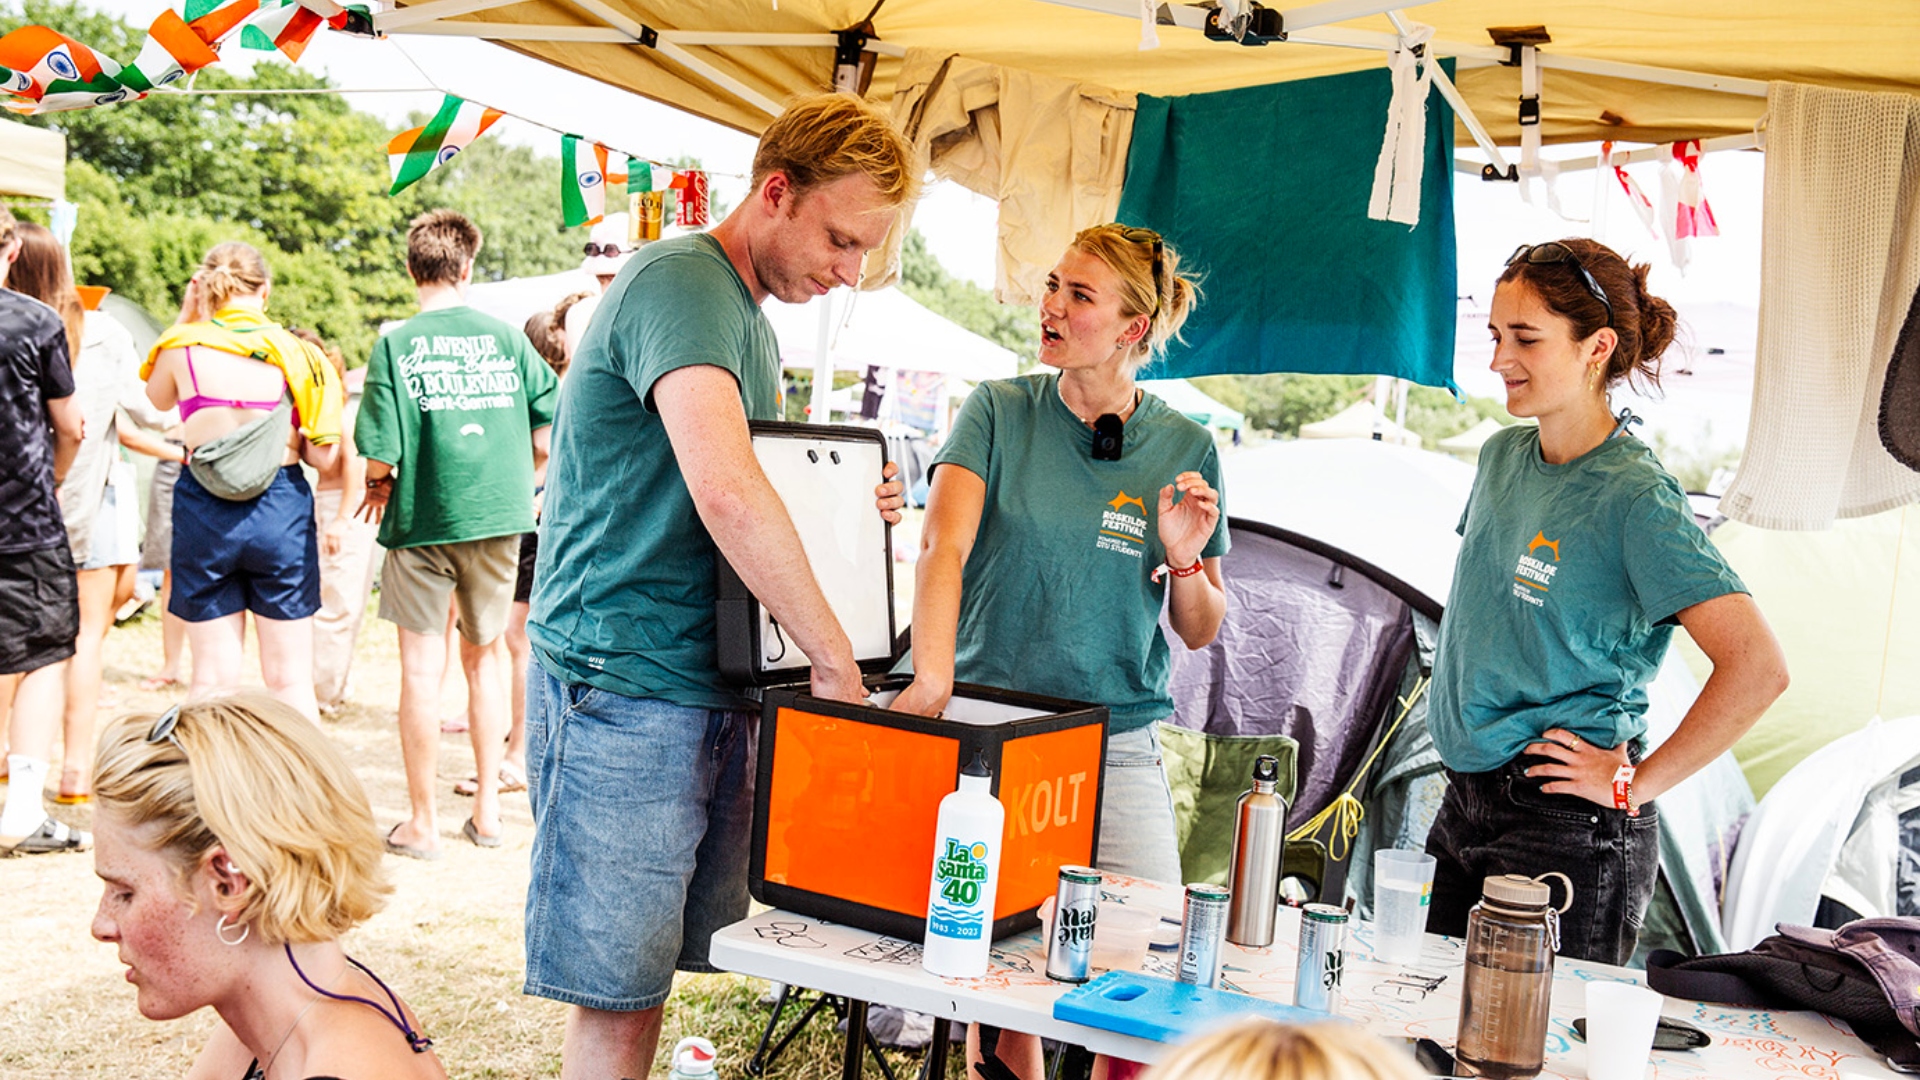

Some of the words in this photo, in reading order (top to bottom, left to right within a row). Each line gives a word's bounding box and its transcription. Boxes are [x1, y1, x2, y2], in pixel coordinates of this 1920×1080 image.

[432, 334, 498, 357] AVENUE
[403, 377, 422, 399] 12
[422, 372, 520, 395] BOULEVARD
[420, 393, 515, 412] Saint-Germain
[1102, 510, 1148, 530] ROSKILDE
[1102, 520, 1144, 538] FESTIVAL
[1111, 545, 1143, 558] STUDENTS
[1008, 771, 1087, 840] KOLT
[947, 841, 969, 863] La
[937, 859, 986, 880] Santa
[943, 878, 978, 904] 40
[957, 926, 979, 936] 2023
